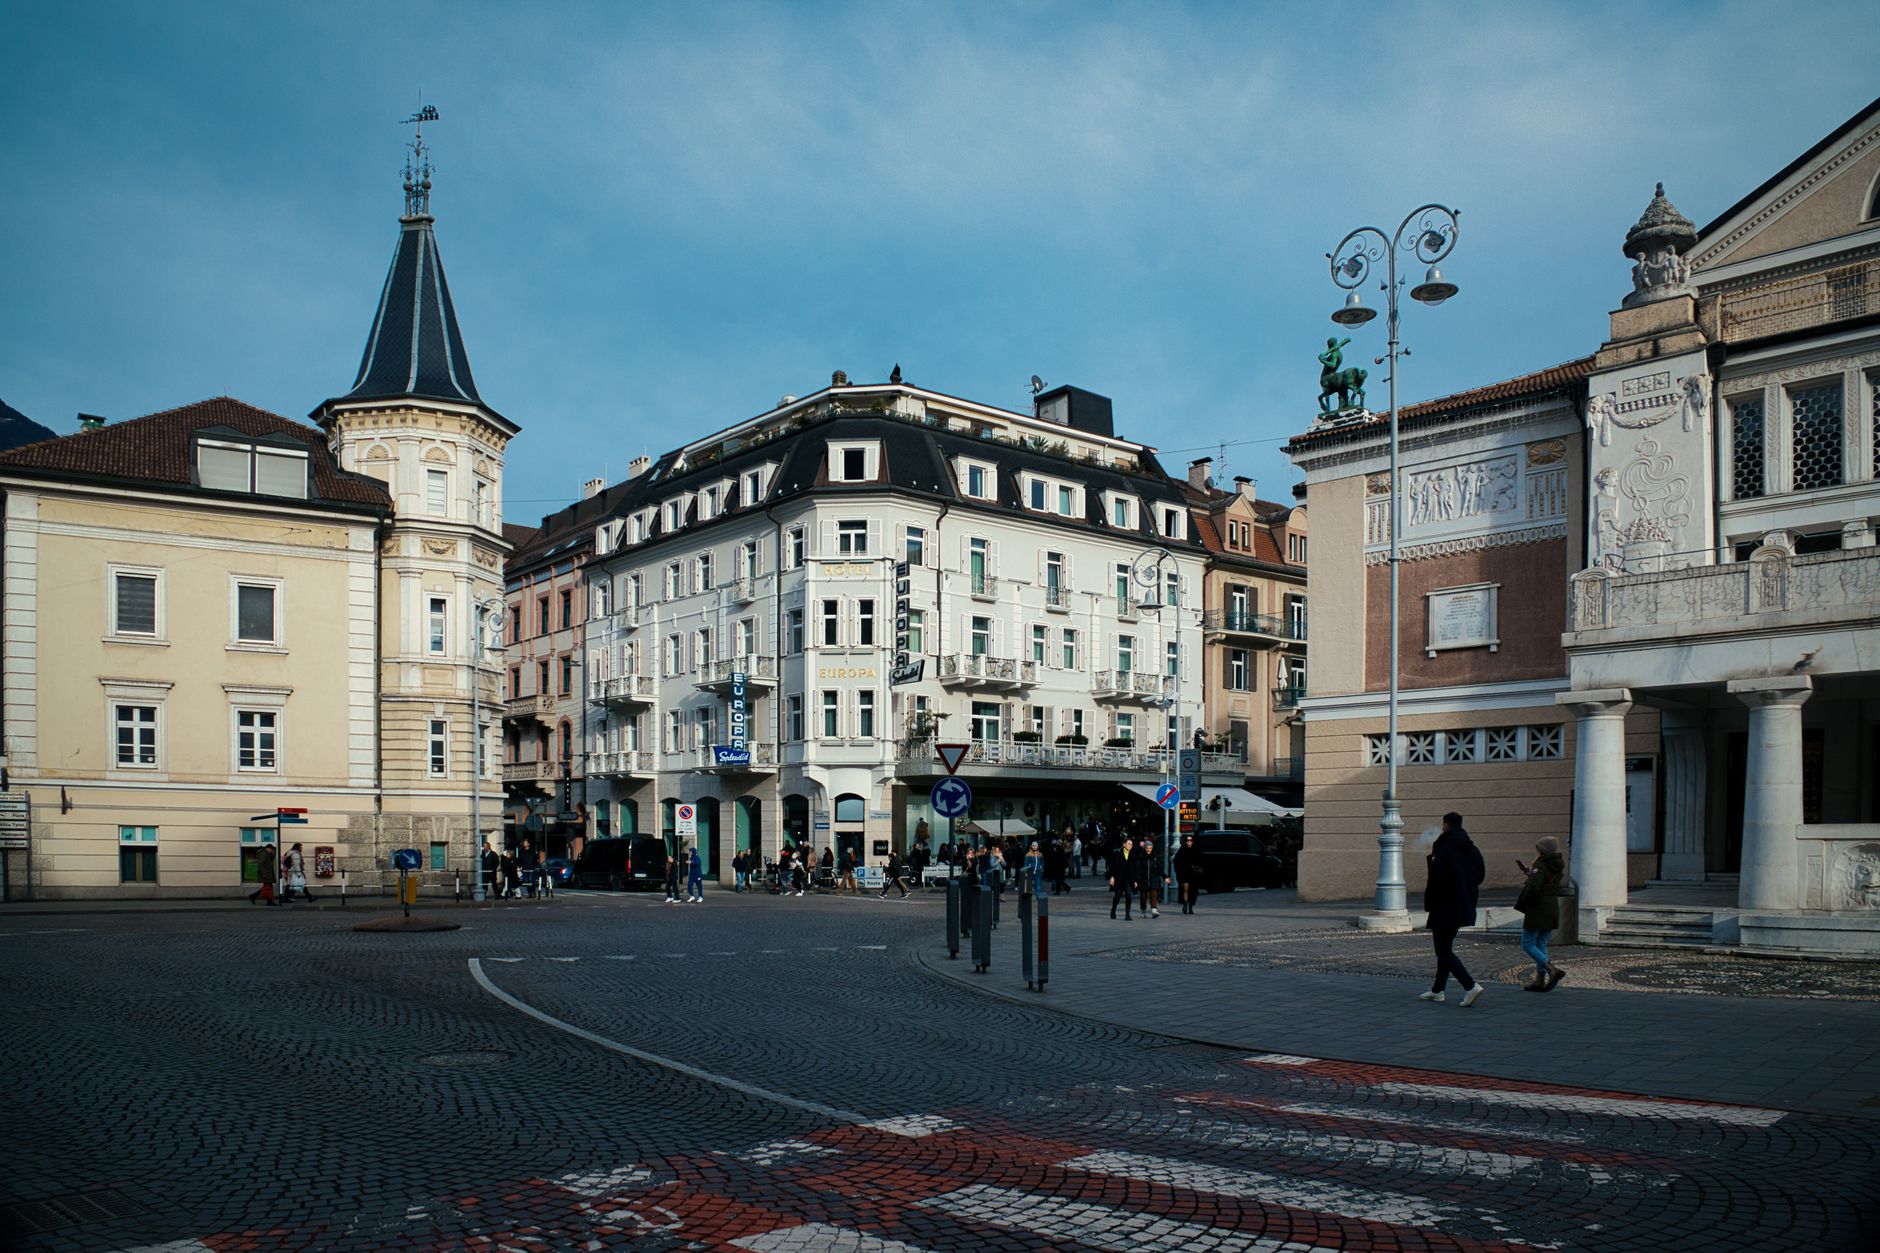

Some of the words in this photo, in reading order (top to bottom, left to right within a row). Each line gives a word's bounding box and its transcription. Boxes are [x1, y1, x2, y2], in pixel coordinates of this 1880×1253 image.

[823, 565, 872, 576] HOTEL
[897, 563, 907, 667] EUROPA
[819, 666, 876, 679] EUROPA
[733, 673, 744, 749] EUROPA
[718, 751, 750, 762] Splendid
